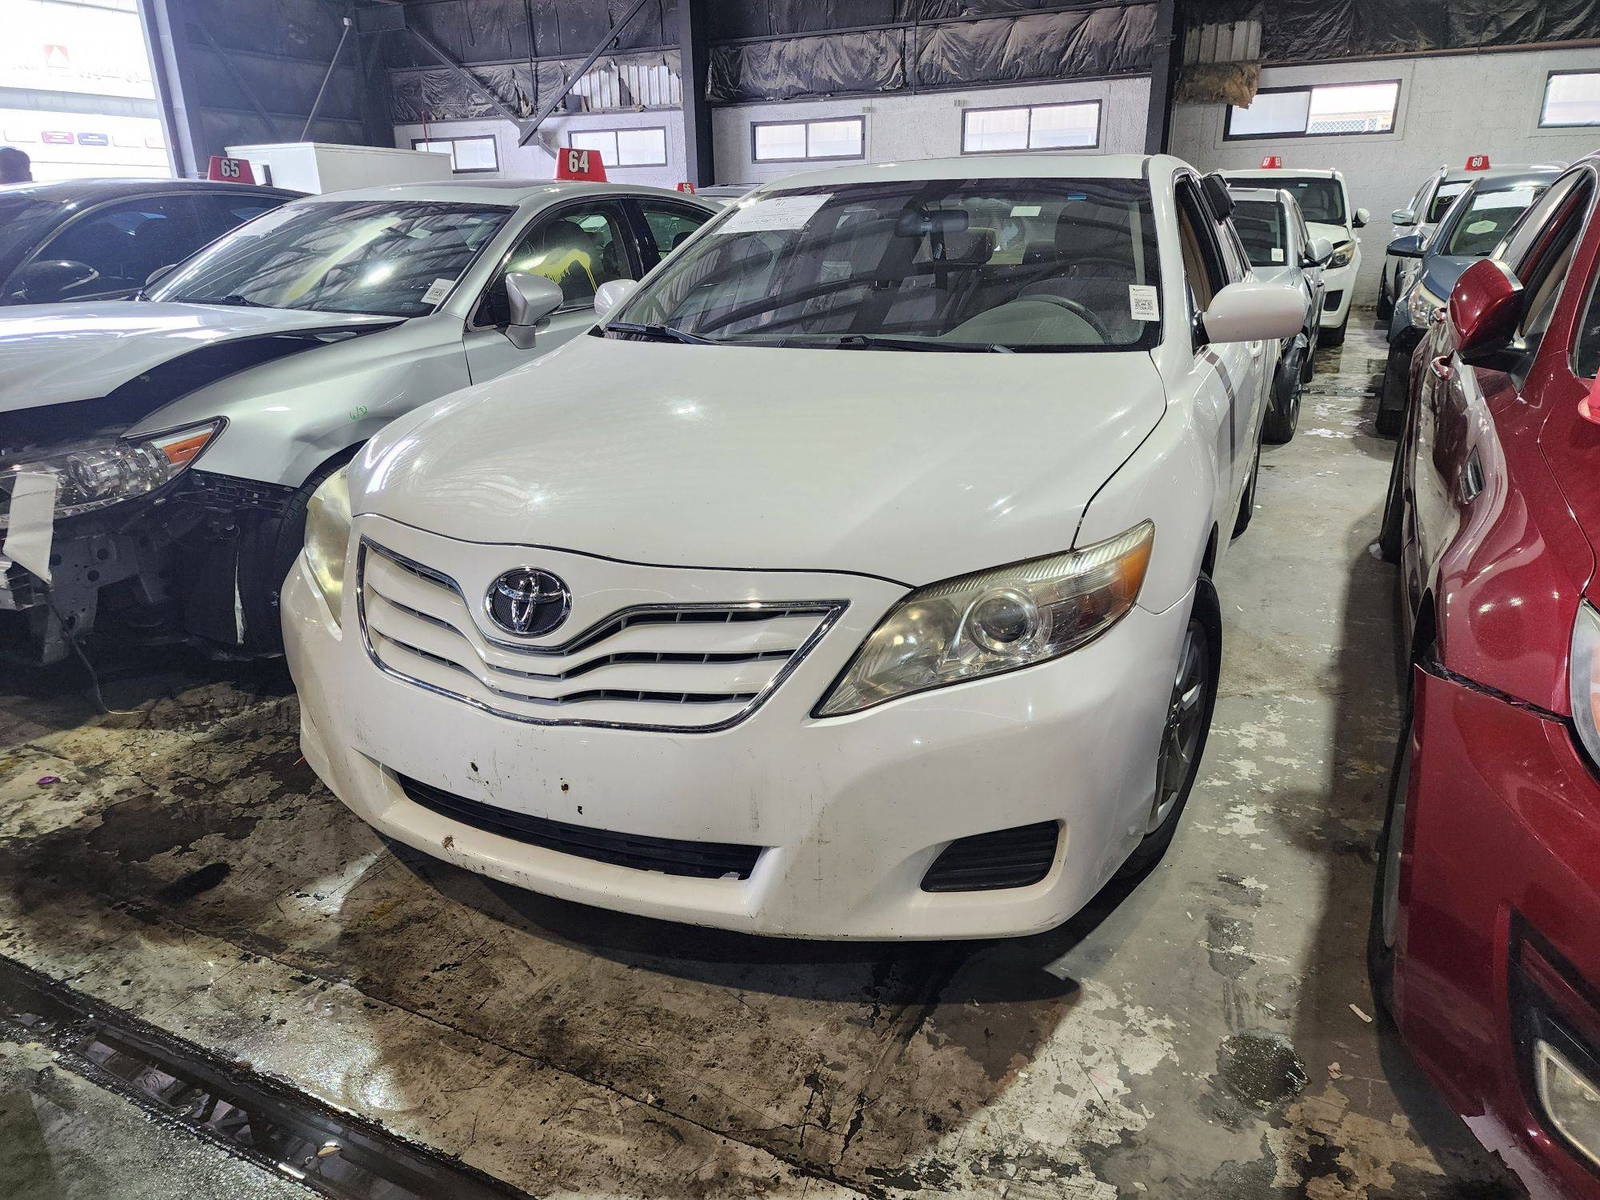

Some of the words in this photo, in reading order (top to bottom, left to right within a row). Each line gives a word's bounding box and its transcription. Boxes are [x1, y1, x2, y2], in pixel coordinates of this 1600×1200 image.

[221, 159, 240, 178] 65
[568, 150, 589, 173] 64
[1472, 157, 1483, 167] 60
